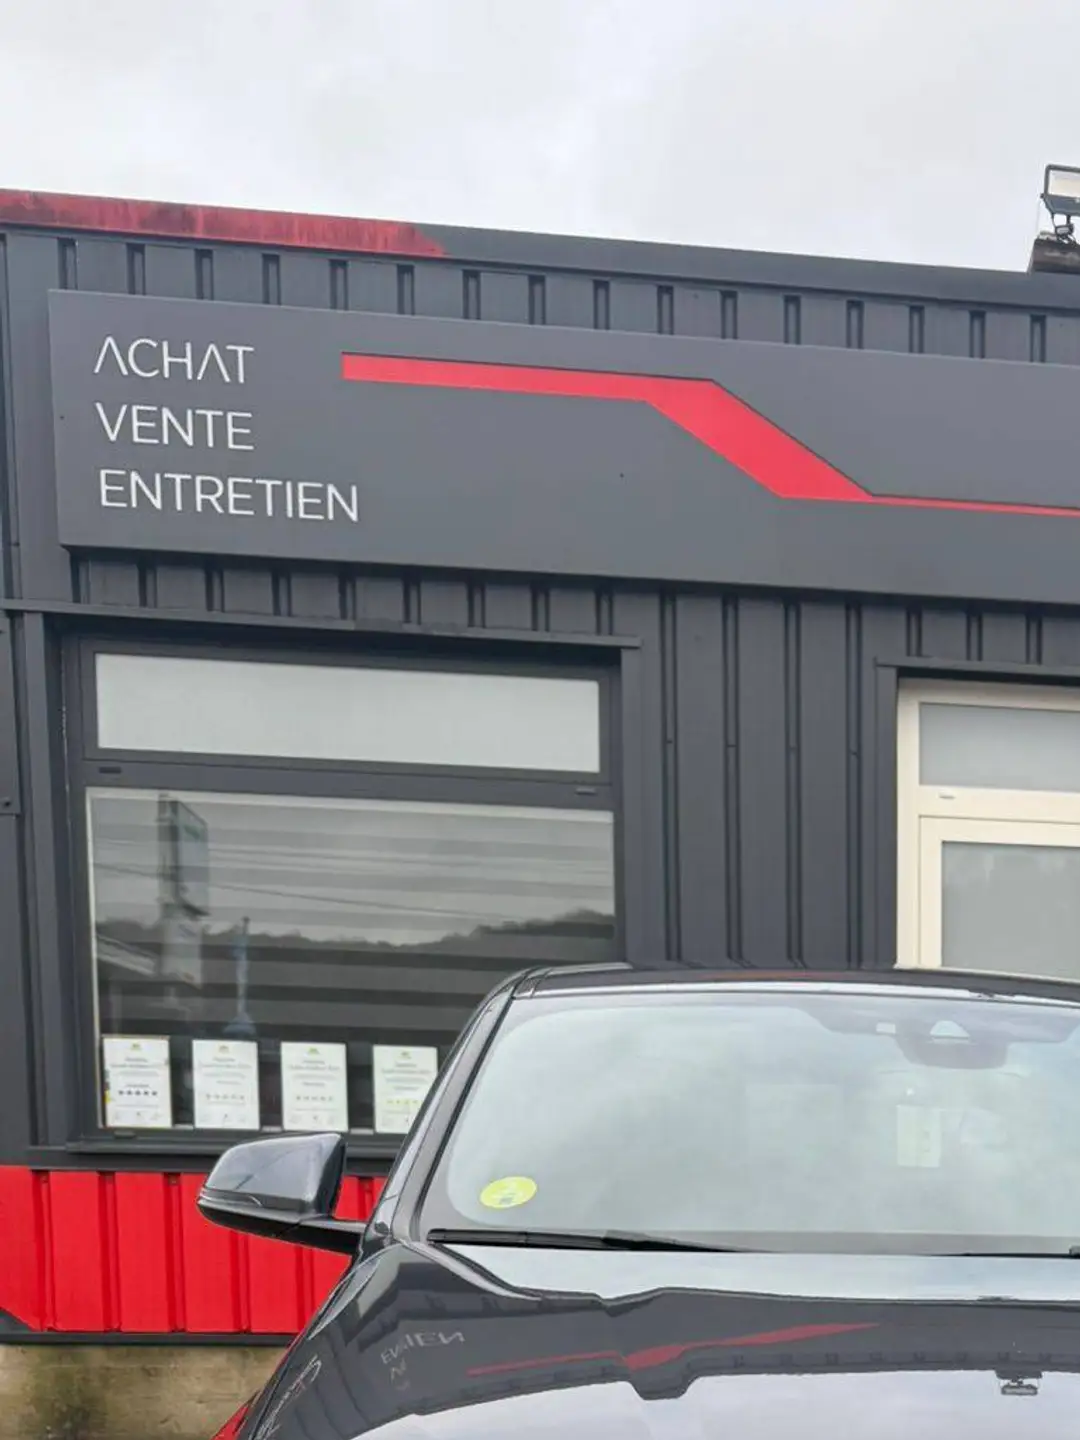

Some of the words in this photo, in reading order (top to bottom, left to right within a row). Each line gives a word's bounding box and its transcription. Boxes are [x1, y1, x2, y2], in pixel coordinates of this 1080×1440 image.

[94, 336, 255, 384] ACHAT
[95, 401, 255, 450] VENTE
[100, 468, 359, 522] ENTRETIEN
